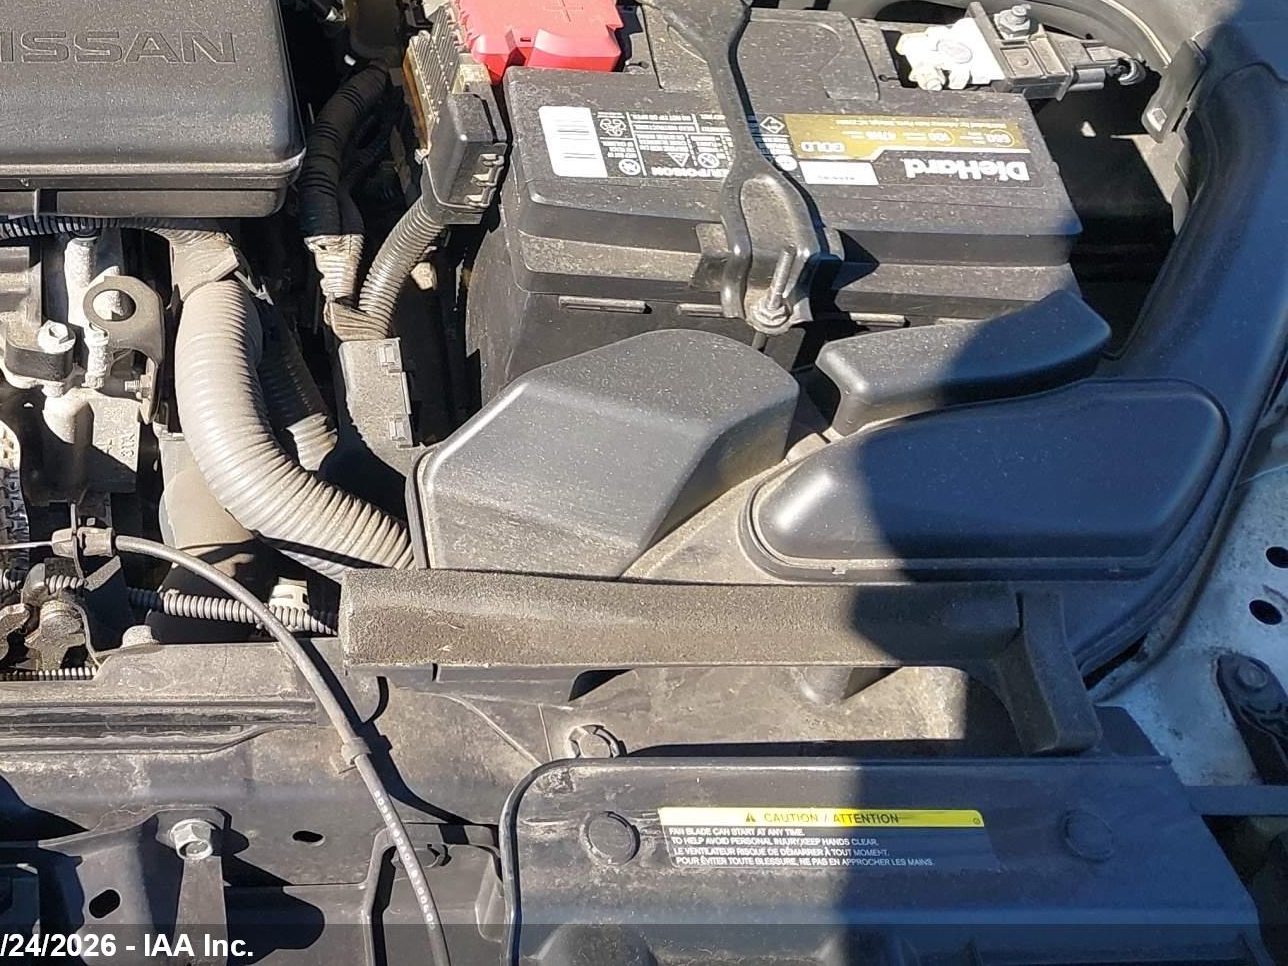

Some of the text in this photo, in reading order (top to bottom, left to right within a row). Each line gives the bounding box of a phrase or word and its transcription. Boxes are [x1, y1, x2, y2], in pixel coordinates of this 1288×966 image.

[904, 157, 1031, 182] DieHard
[764, 813, 818, 823] CAUTION
[833, 813, 899, 824] ATTENTION
[732, 828, 755, 836] START
[756, 828, 767, 836] AT
[768, 828, 784, 836] ANY
[672, 837, 683, 845] TO
[684, 837, 704, 845] HELP
[731, 838, 773, 846] PERSONAL
[821, 838, 850, 846] HANDS
[851, 838, 879, 846] CLEAR.
[674, 847, 685, 855] LE
[685, 847, 736, 856] VENTILATEUR
[736, 847, 768, 856] RISQUE
[768, 848, 780, 856] DE
[831, 848, 852, 856] TOUT
[853, 848, 890, 856] MOMENT.
[677, 856, 700, 865] POUR
[728, 857, 755, 865] TOUTE
[799, 857, 812, 865] NE
[812, 857, 828, 866] PAS
[841, 858, 890, 866] APPROCHER
[892, 858, 907, 866] LES
